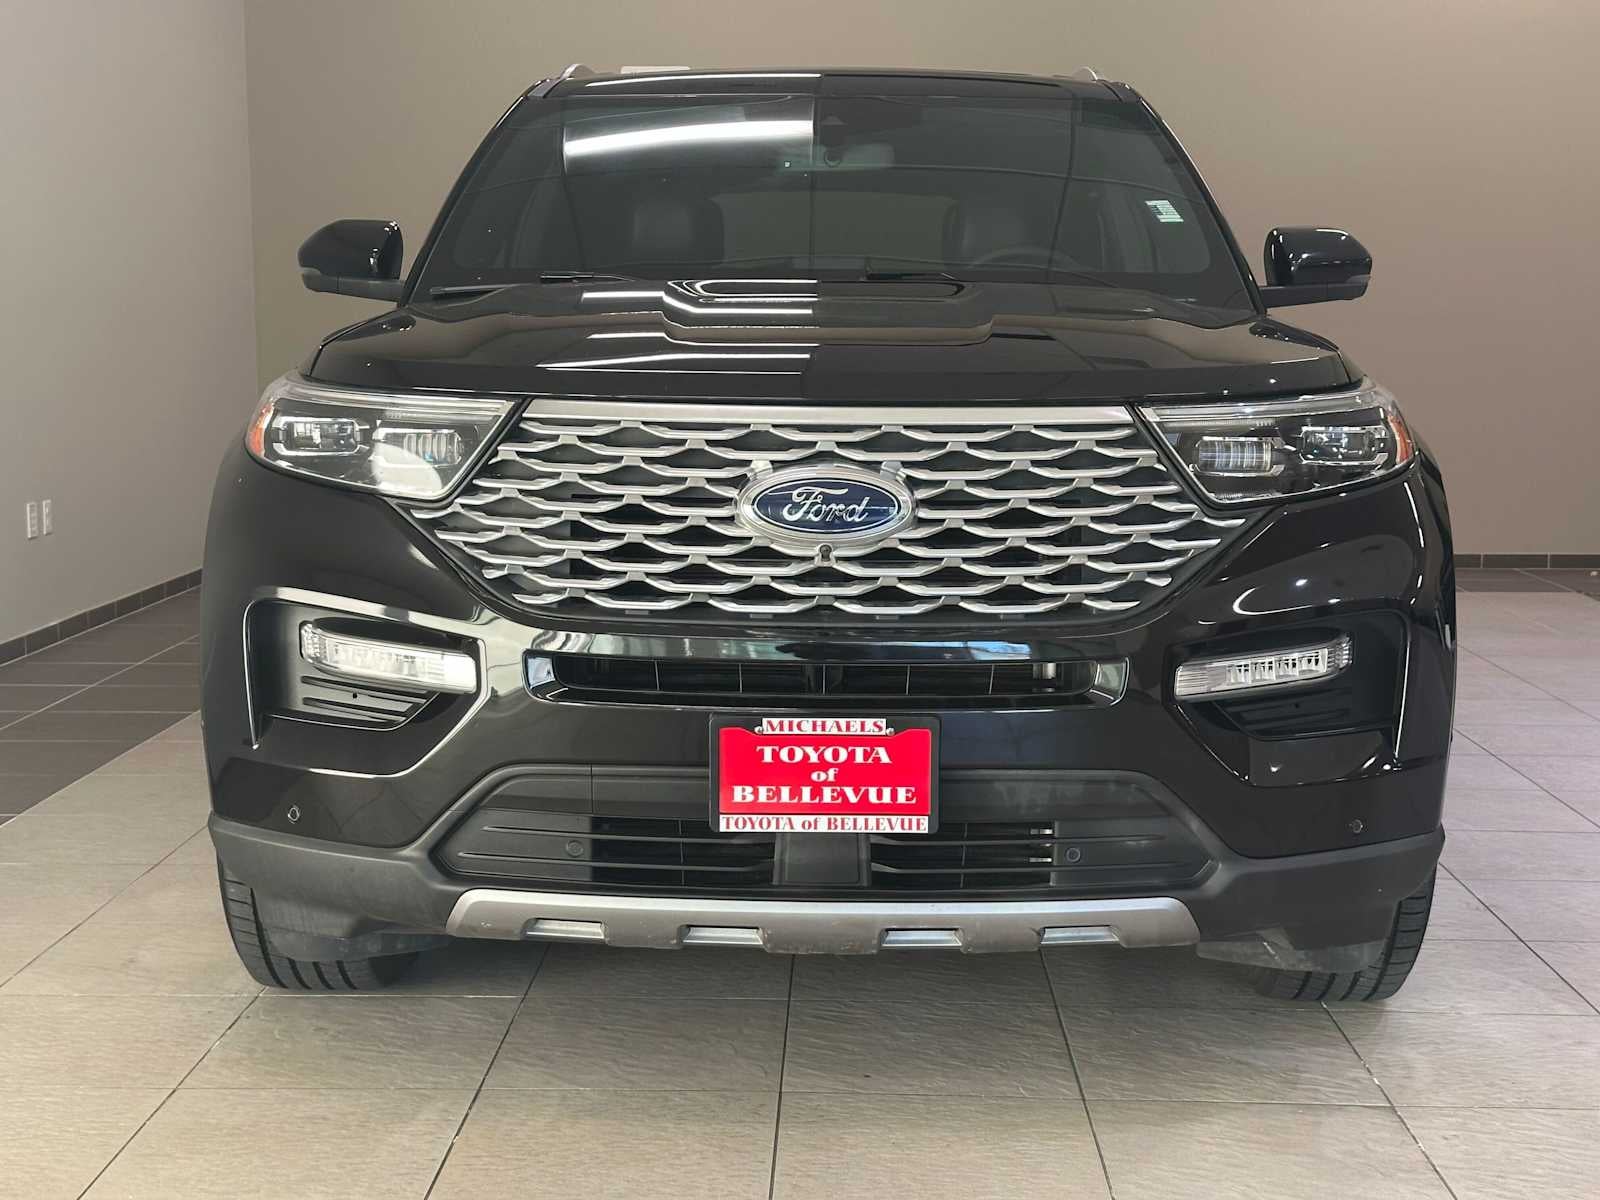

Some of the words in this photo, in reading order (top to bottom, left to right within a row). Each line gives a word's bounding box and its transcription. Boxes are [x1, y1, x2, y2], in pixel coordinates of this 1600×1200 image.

[768, 486, 870, 522] Ford
[764, 719, 884, 733] MICHAELS
[756, 745, 892, 764] TOYOTA
[811, 768, 838, 782] of
[732, 785, 917, 804] BELLEVUE
[722, 816, 795, 831] TOYOTA
[801, 816, 820, 831] of
[827, 817, 927, 832] BELLEVUE
